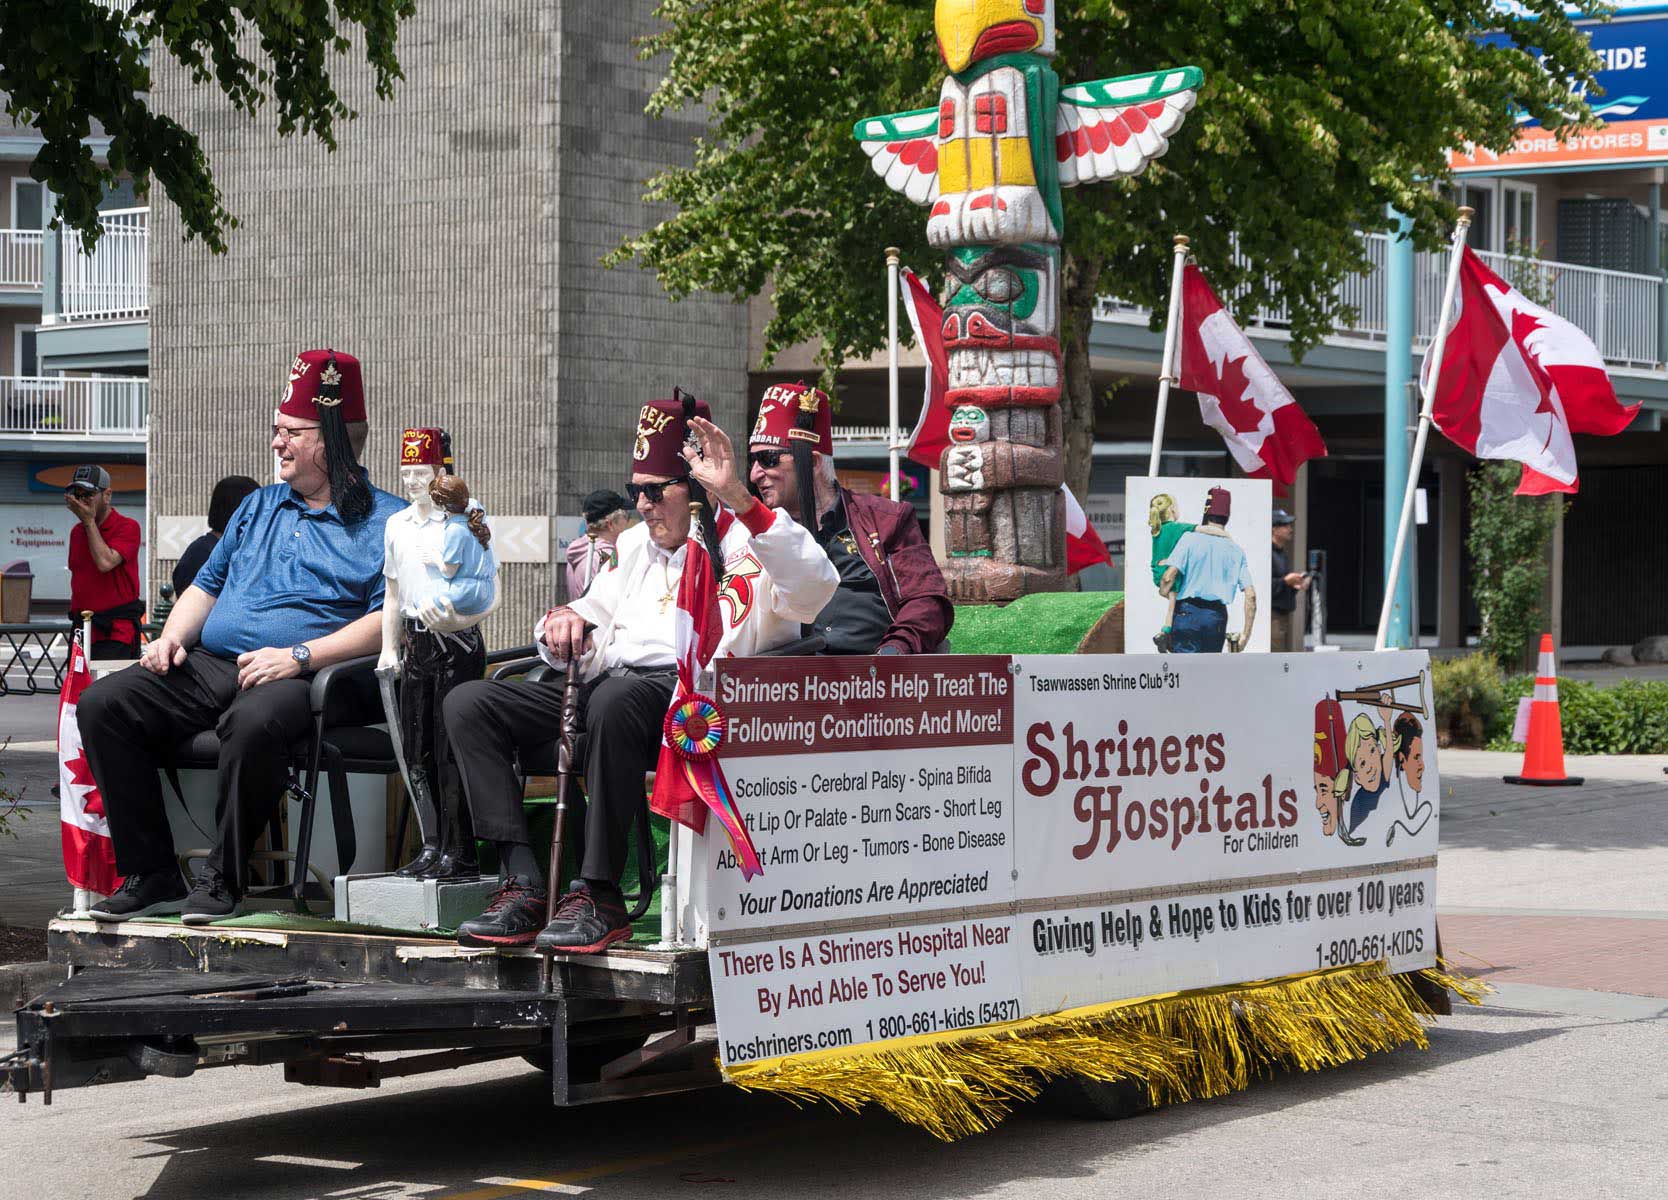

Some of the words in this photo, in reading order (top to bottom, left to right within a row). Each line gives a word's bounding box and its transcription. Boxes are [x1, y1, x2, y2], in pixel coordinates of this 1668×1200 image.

[1596, 46, 1647, 71] SIDE
[1566, 133, 1643, 152] STORES
[16, 526, 54, 535] Vehicles
[16, 539, 65, 548] Equipment
[722, 677, 799, 704] Shriners
[804, 675, 886, 705] Hospitals
[891, 677, 929, 703] Help
[934, 675, 975, 697] Treat
[978, 672, 1008, 696] The
[1030, 675, 1100, 692] Tsawwassen
[1103, 673, 1137, 690] Shrine
[727, 715, 815, 746] Following
[821, 711, 914, 740] Conditions
[919, 710, 951, 735] And
[956, 709, 1002, 733] More!
[1022, 719, 1225, 797] Shriners
[735, 776, 798, 799] Scoliosis
[811, 770, 868, 794] Cerebral
[872, 769, 906, 793] Palsy
[918, 766, 953, 788] Spina
[957, 765, 992, 784] Bifida
[759, 812, 780, 835] Lip
[784, 810, 801, 829] Or
[805, 808, 848, 828] Palate
[861, 804, 892, 824] Burn
[895, 802, 931, 822] Scars
[943, 799, 976, 818] Short
[979, 798, 1002, 819] Leg
[1072, 774, 1298, 860] Hospitals
[716, 848, 767, 870] Abnt
[770, 846, 799, 865] Arm
[803, 843, 820, 863] Or
[824, 842, 849, 864] Leg
[862, 838, 910, 858] Tumors
[922, 832, 955, 852] Bone
[958, 830, 1006, 849] Disease
[1224, 836, 1244, 854] For
[1247, 834, 1299, 852] Children
[739, 892, 777, 916] Your
[780, 885, 862, 912] Donations
[866, 882, 894, 903] Are
[898, 870, 989, 902] Appreciated
[1032, 917, 1095, 957] Giving
[1102, 909, 1142, 946] Help
[1149, 905, 1162, 937] &
[1169, 901, 1214, 936] Hope
[1219, 901, 1237, 930] to
[1243, 892, 1282, 927] Kids
[1286, 886, 1312, 921] for
[1317, 890, 1353, 918] over
[1357, 882, 1384, 912] 100
[1388, 879, 1425, 915] years
[719, 951, 774, 977] There
[779, 946, 796, 970] Is
[801, 942, 815, 968] A
[819, 937, 894, 965] Shriners
[898, 926, 968, 956] Hospital
[972, 923, 1011, 946] Near
[1315, 927, 1424, 968] 1-800-661-KIDS
[757, 986, 782, 1018] By
[787, 981, 823, 1010] And
[828, 974, 868, 1004] Able
[872, 972, 893, 998] To
[898, 968, 946, 994] Serve
[949, 961, 987, 988] You!
[725, 1027, 852, 1063] bcshriners.com
[866, 1020, 874, 1041] 1
[879, 1007, 975, 1039] 800-661-kids
[978, 999, 1021, 1024] (5437)
